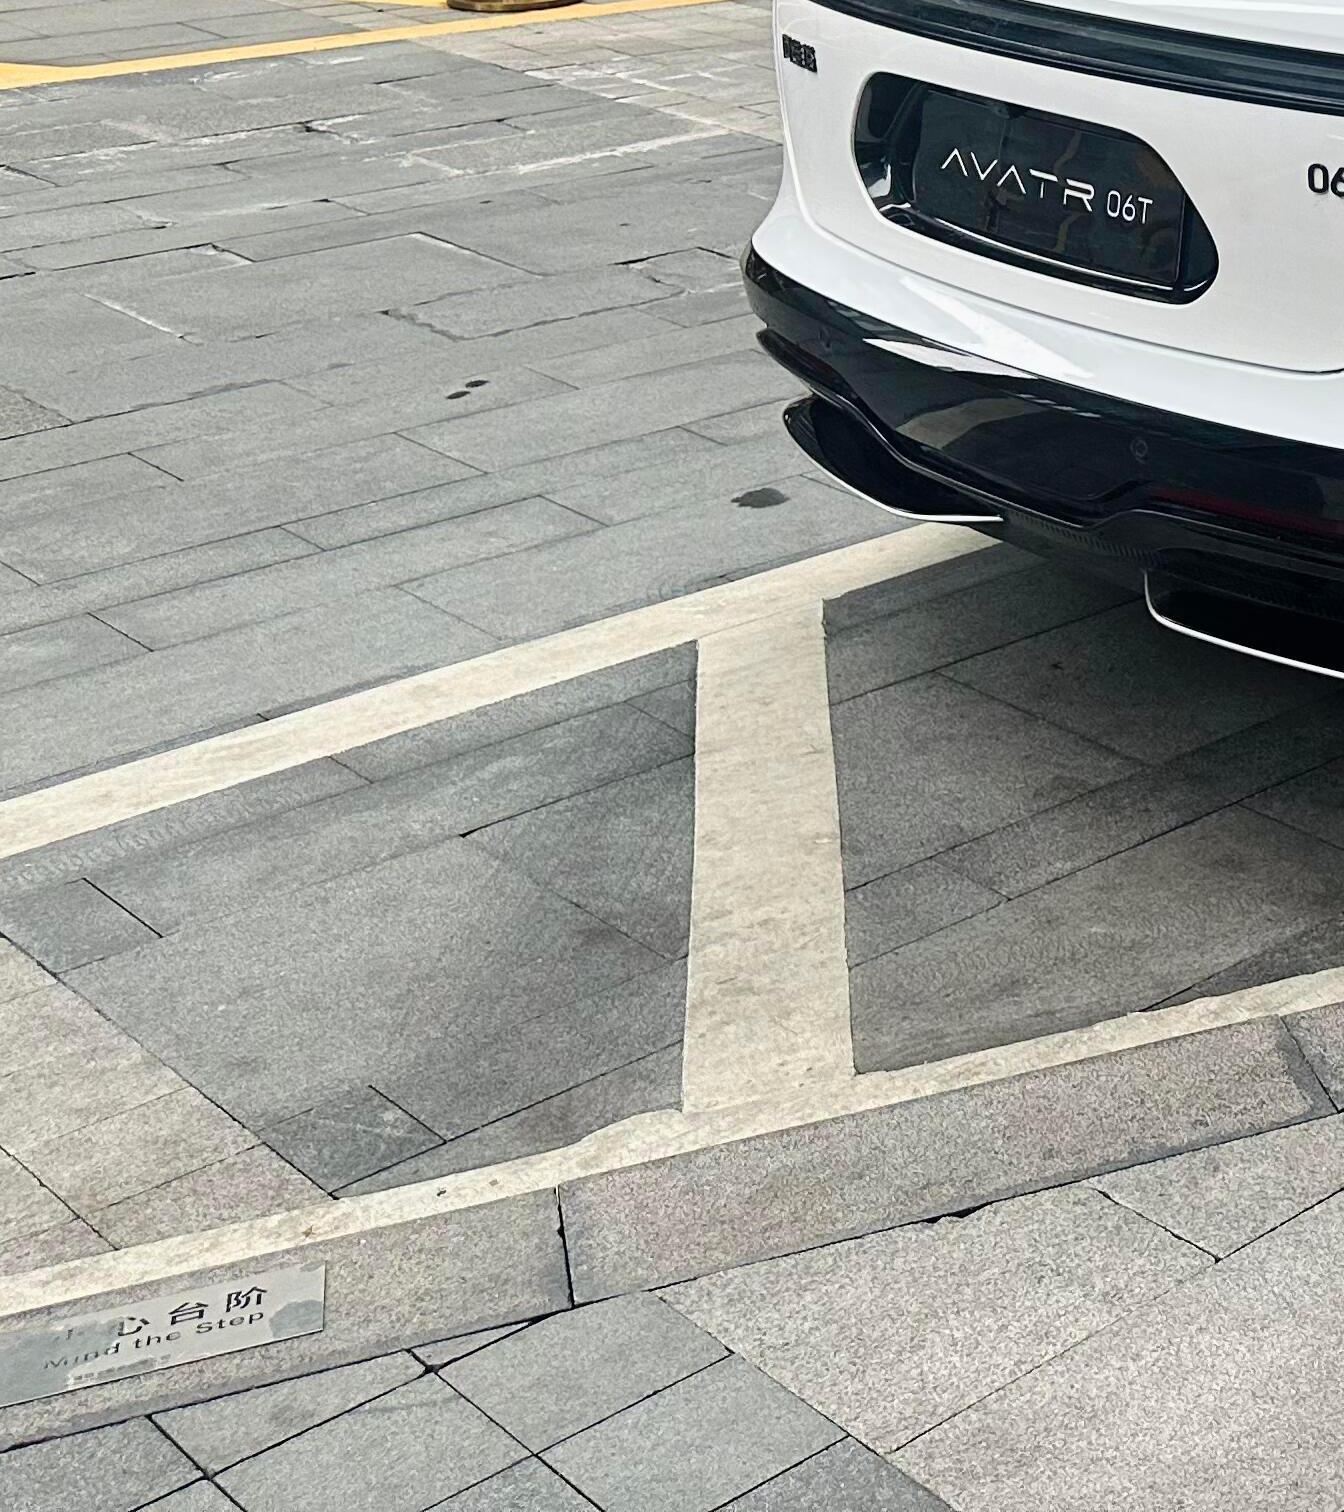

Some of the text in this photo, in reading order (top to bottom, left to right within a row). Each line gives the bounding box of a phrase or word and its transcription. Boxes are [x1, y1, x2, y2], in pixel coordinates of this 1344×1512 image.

[941, 147, 1154, 224] AVATR 06T
[134, 1329, 182, 1350] the
[195, 1310, 265, 1336] Step
